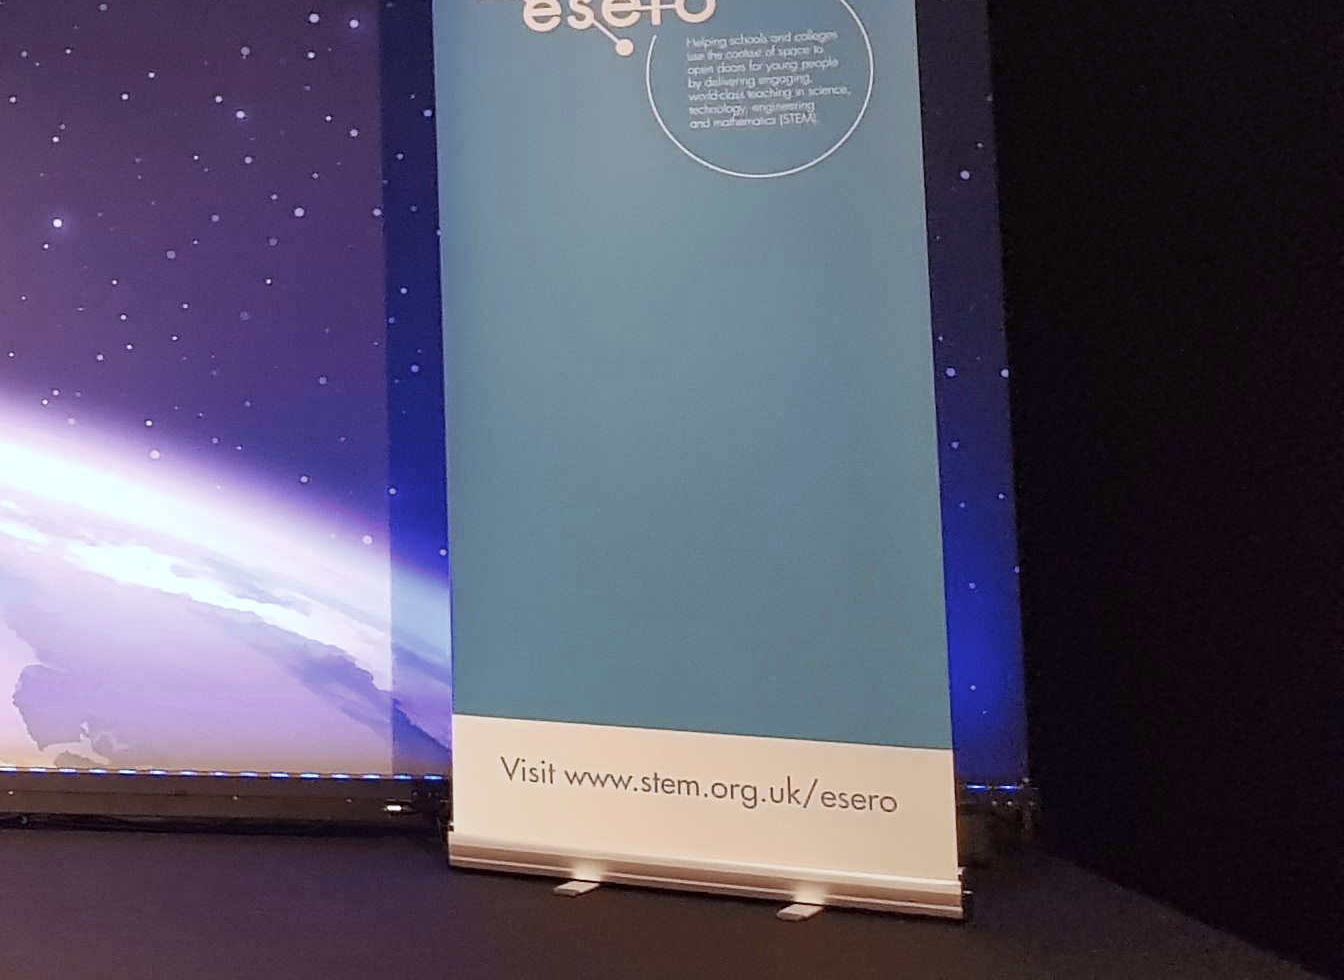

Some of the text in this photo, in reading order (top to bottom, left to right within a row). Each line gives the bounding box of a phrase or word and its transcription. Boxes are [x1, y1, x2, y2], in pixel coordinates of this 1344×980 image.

[686, 36, 727, 50] Helping
[730, 33, 769, 46] schools
[771, 32, 791, 43] and
[765, 46, 776, 57] of
[778, 47, 811, 59] space
[814, 45, 824, 55] to
[688, 66, 713, 77] open
[749, 60, 762, 71] for
[766, 61, 798, 75] young
[801, 58, 839, 71] people
[688, 78, 702, 90] by
[796, 86, 804, 96] in
[690, 117, 710, 128] and
[501, 755, 898, 814] Visit www.stem.org.uk/esero
